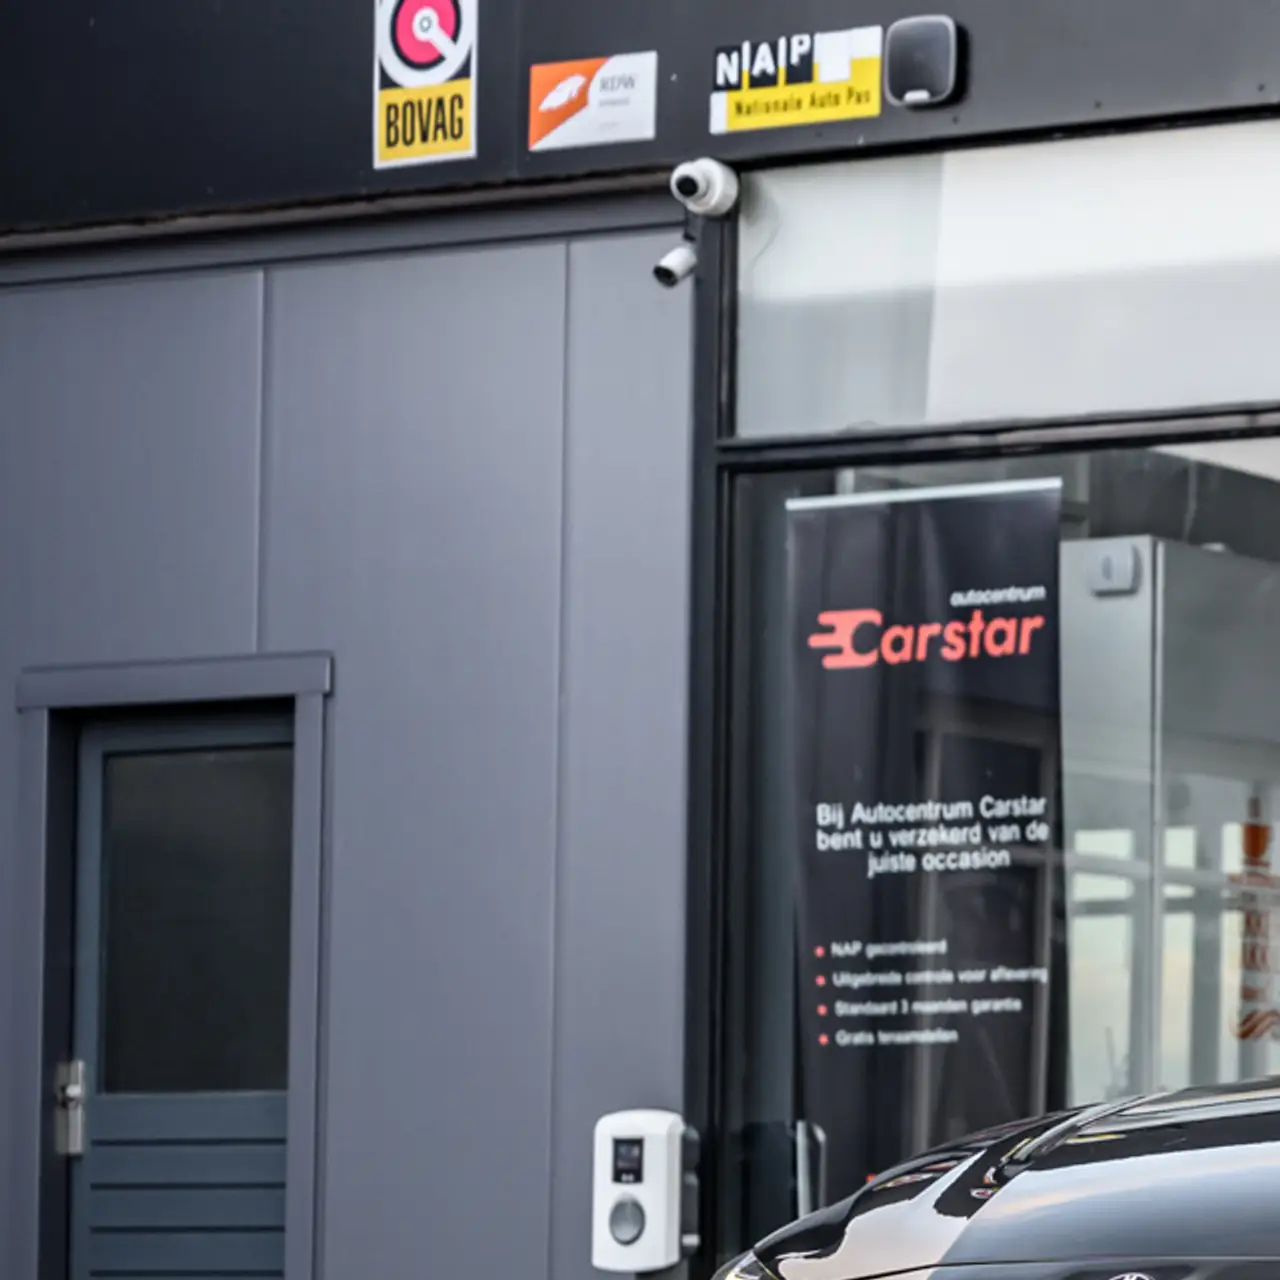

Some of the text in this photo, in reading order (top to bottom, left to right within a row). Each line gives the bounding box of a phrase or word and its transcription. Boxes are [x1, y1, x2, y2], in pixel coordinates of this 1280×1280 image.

[716, 34, 812, 86] NAP
[735, 86, 871, 115] Nationale Auto Pas
[385, 94, 465, 149] BOVAG
[950, 585, 1047, 607] autocentrum
[807, 608, 1046, 670] Carstar
[816, 795, 1047, 830] Bij Autocentrum Carstar
[816, 821, 1049, 851] bent u verzekerd van de
[867, 847, 1011, 879] juiste occasion
